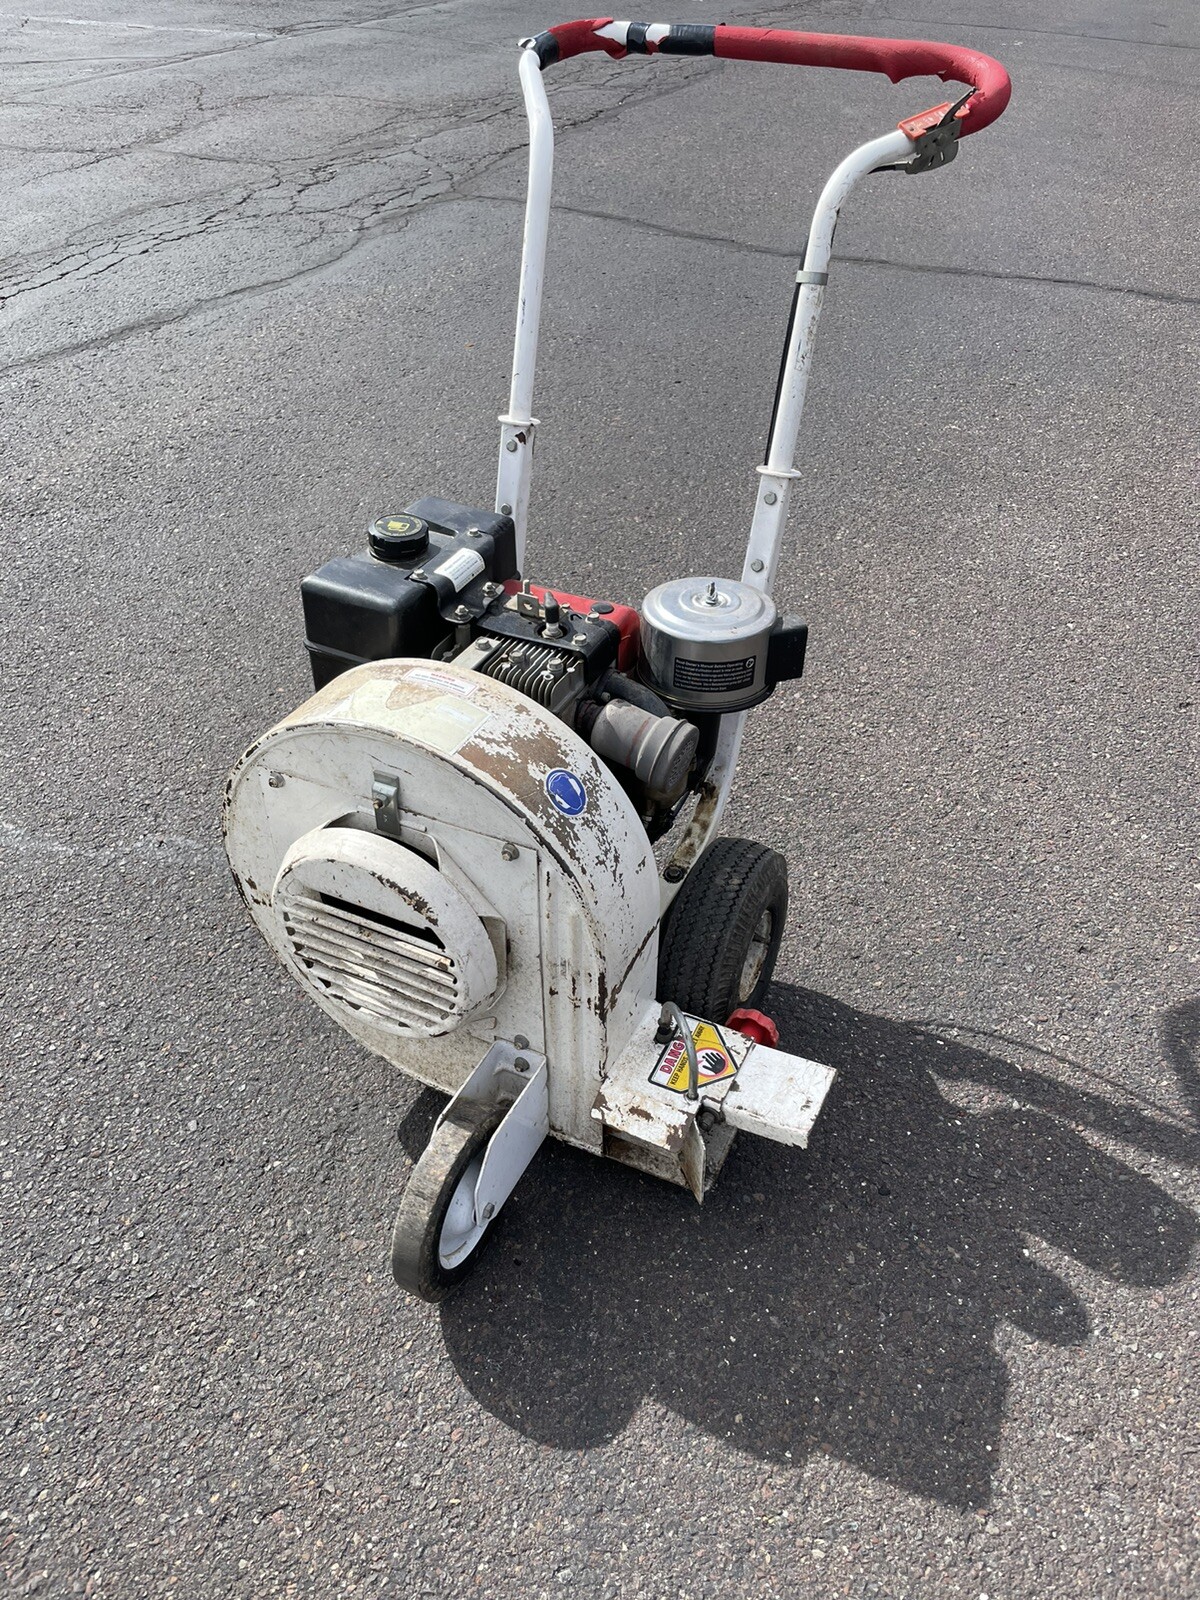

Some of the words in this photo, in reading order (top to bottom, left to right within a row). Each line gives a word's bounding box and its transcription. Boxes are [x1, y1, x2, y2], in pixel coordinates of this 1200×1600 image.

[660, 1034, 687, 1074] DANG
[670, 1072, 680, 1085] KEEP
[695, 1026, 705, 1038] AWAY
